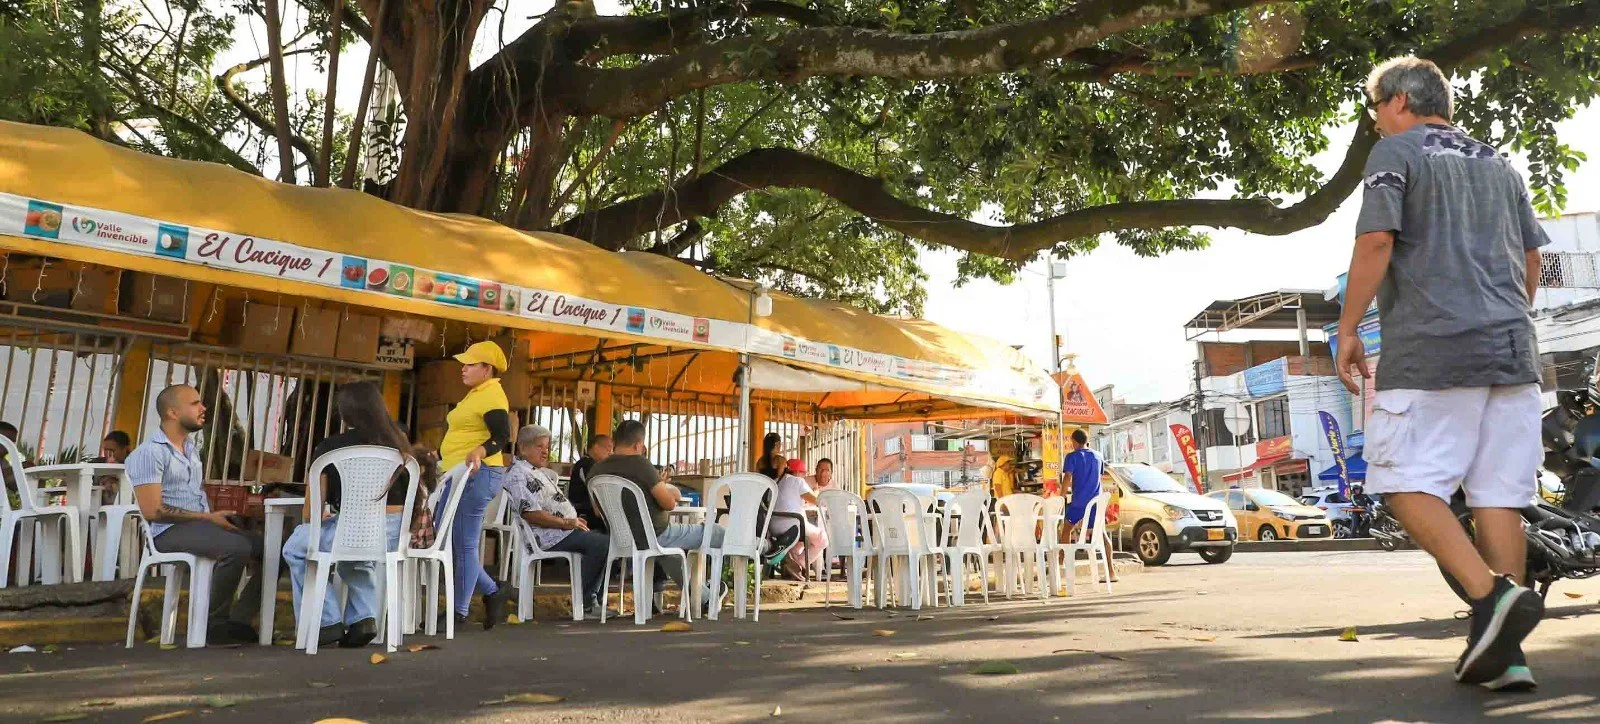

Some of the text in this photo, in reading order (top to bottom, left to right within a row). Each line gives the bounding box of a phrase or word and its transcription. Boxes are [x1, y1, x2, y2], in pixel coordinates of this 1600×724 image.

[97, 222, 122, 233] Valle
[97, 229, 149, 245] Invencible
[197, 232, 334, 278] El Cacique 1
[526, 292, 622, 325] El Cacique 1
